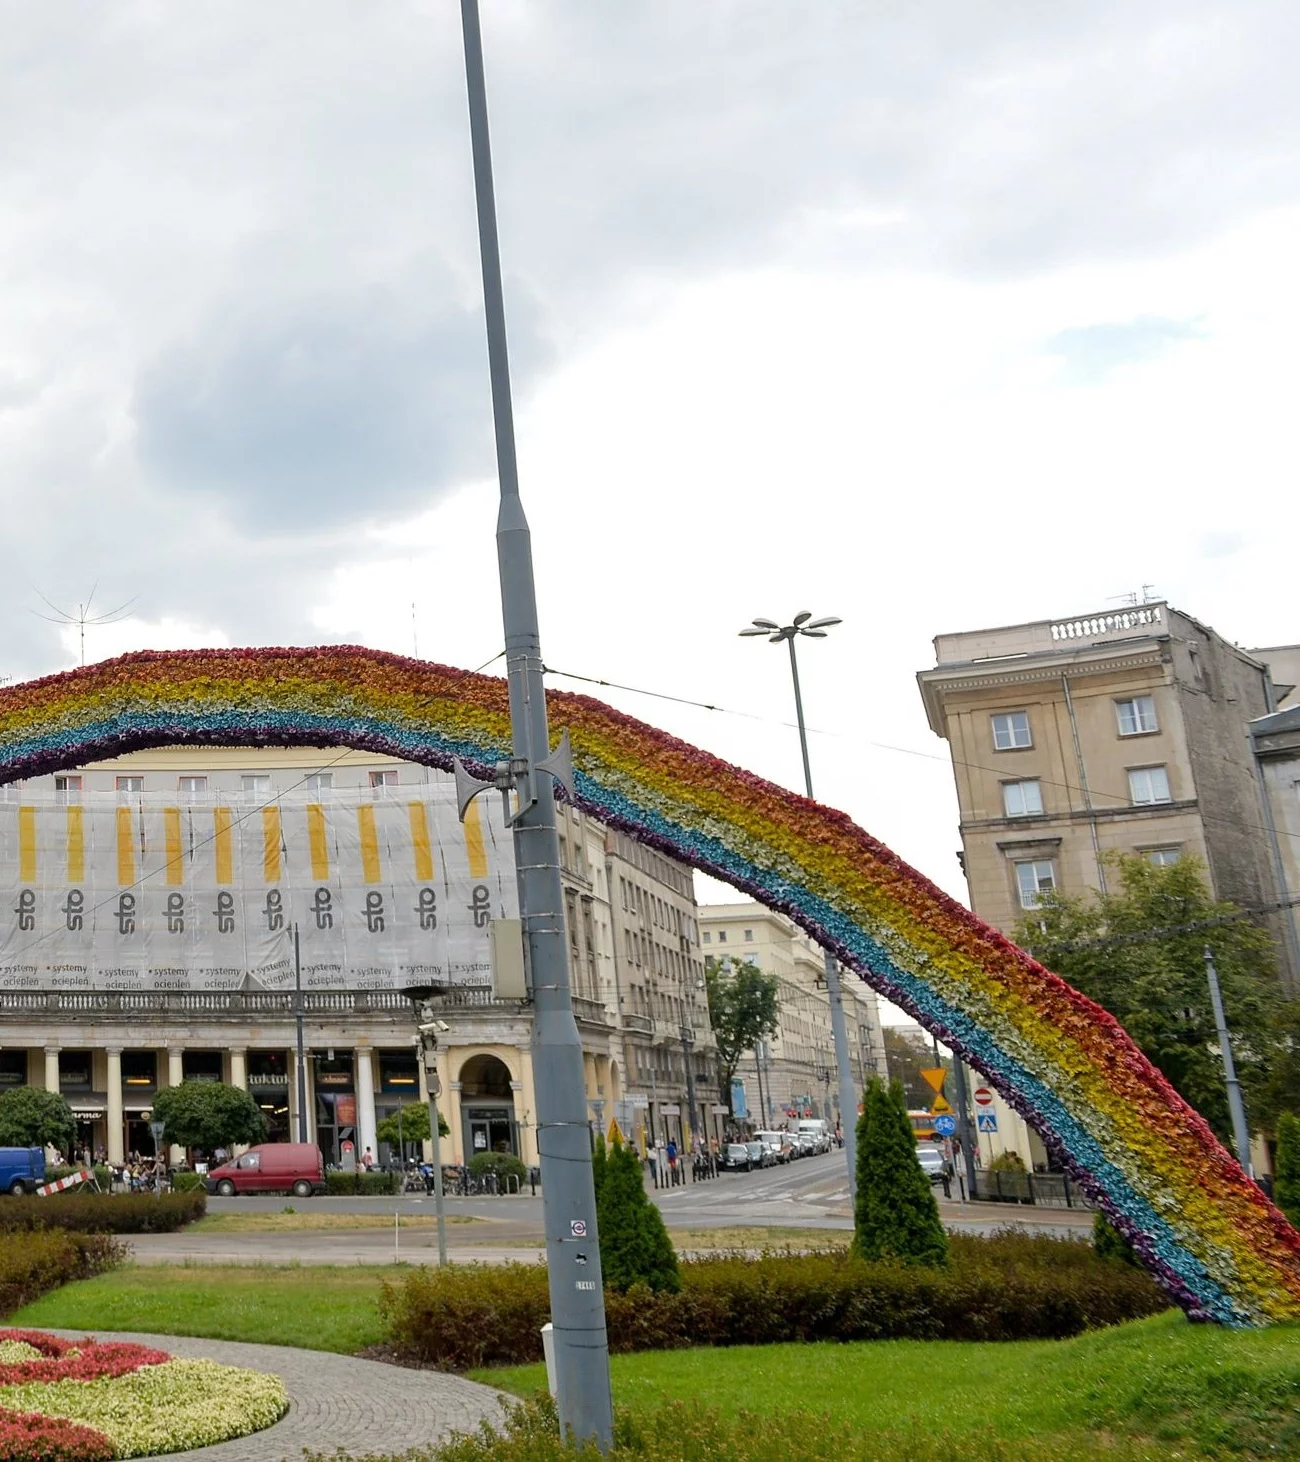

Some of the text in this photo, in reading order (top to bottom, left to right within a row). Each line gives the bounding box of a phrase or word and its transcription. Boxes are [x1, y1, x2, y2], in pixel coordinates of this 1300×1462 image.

[14, 889, 35, 931] sto
[61, 889, 84, 931] sto
[113, 893, 136, 935] sto
[162, 892, 184, 934] sto
[212, 891, 235, 934] sto
[262, 889, 283, 931] sto
[310, 887, 333, 930] sto
[361, 891, 385, 933] sto
[413, 887, 437, 931] sto
[4, 965, 38, 974] systemy
[52, 964, 87, 973] systemy
[104, 968, 139, 977] systemy
[154, 967, 189, 976] systemy
[206, 968, 241, 976] systemy
[257, 958, 290, 974] systemy
[307, 963, 341, 973] systemy
[356, 968, 392, 977] systemy
[406, 965, 441, 975] systemy
[71, 1111, 101, 1119] arma
